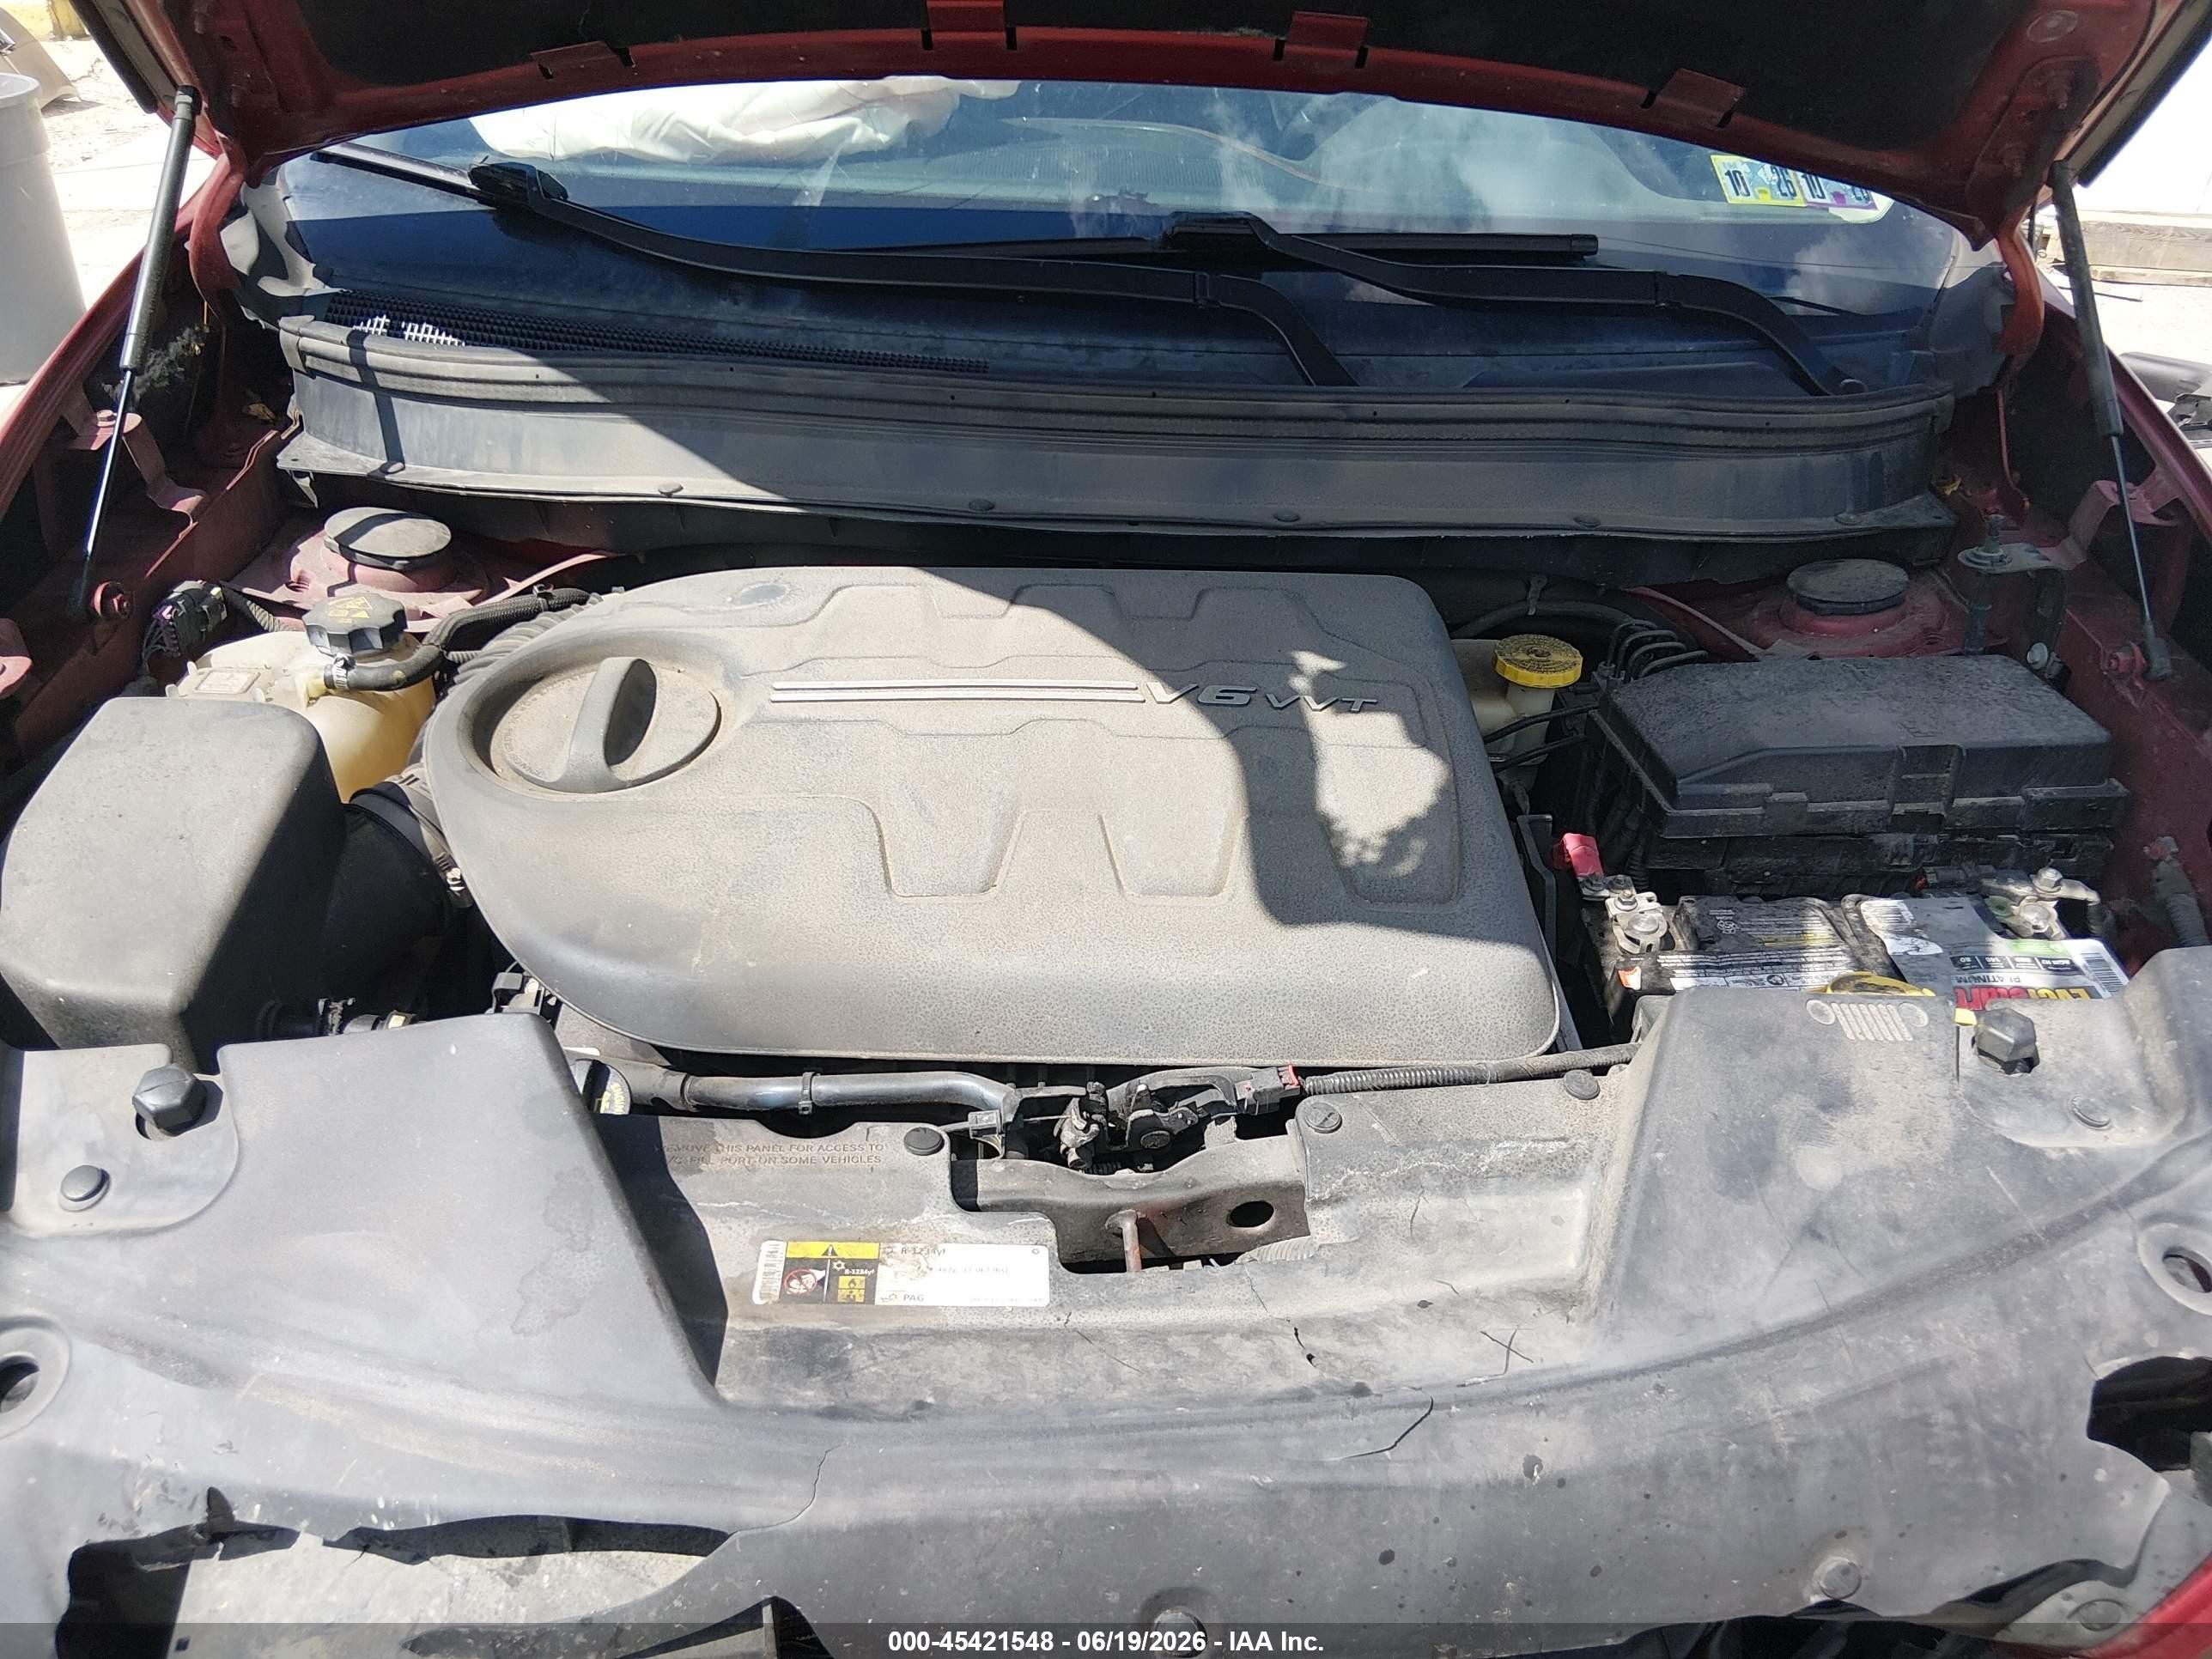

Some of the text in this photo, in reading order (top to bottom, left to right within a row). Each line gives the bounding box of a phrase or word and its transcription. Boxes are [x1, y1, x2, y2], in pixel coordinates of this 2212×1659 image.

[1724, 165, 1796, 199] 10 26
[1801, 173, 1826, 199] 10
[1146, 682, 1378, 713] V6 VVT
[1956, 975, 2021, 984] PLATINUM
[716, 1144, 743, 1153] THIS
[746, 1144, 785, 1152] PANEL
[789, 1144, 813, 1152] FOR
[817, 1144, 865, 1152] ACCESS
[868, 1143, 884, 1152] TO
[720, 1156, 754, 1165] PORT
[781, 1156, 817, 1164] SOME
[822, 1155, 881, 1164] VEHICLES
